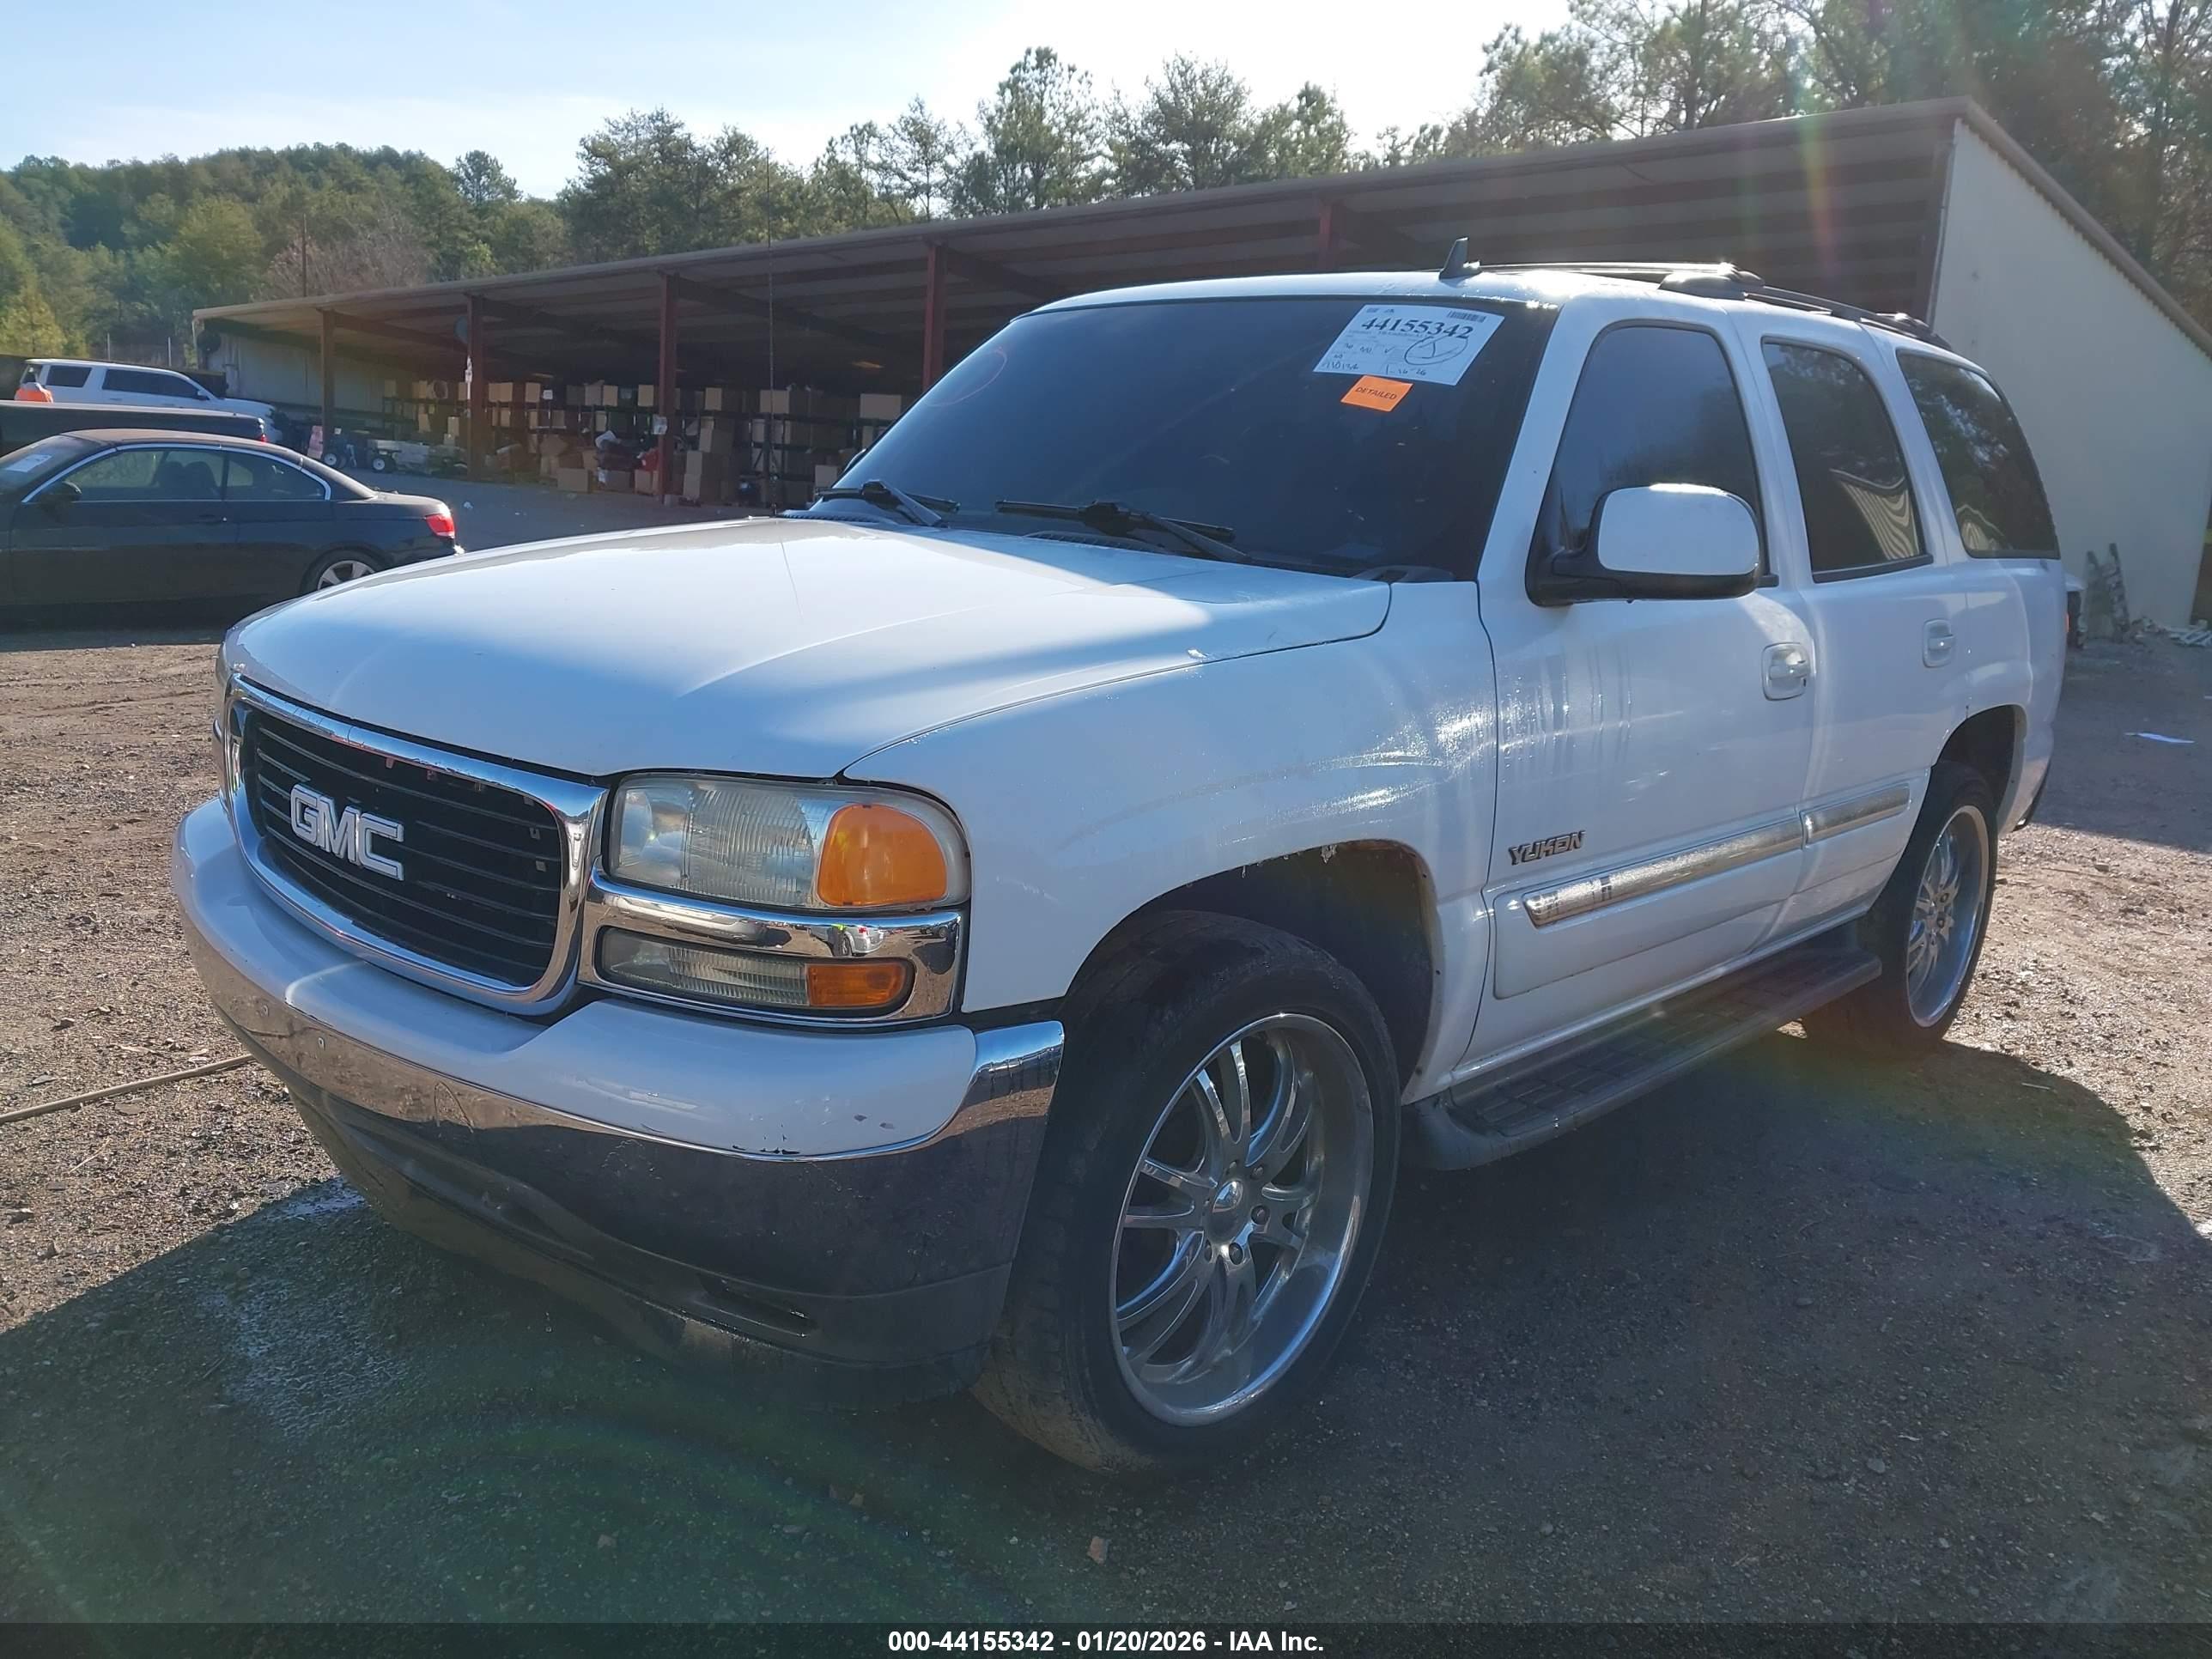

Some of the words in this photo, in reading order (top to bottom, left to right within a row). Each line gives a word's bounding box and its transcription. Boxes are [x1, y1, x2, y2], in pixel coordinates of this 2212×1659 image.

[1361, 317, 1474, 339] 44155342
[1355, 386, 1398, 401] DETAILED
[290, 783, 404, 881] GMC
[1509, 830, 1586, 866] YUKON
